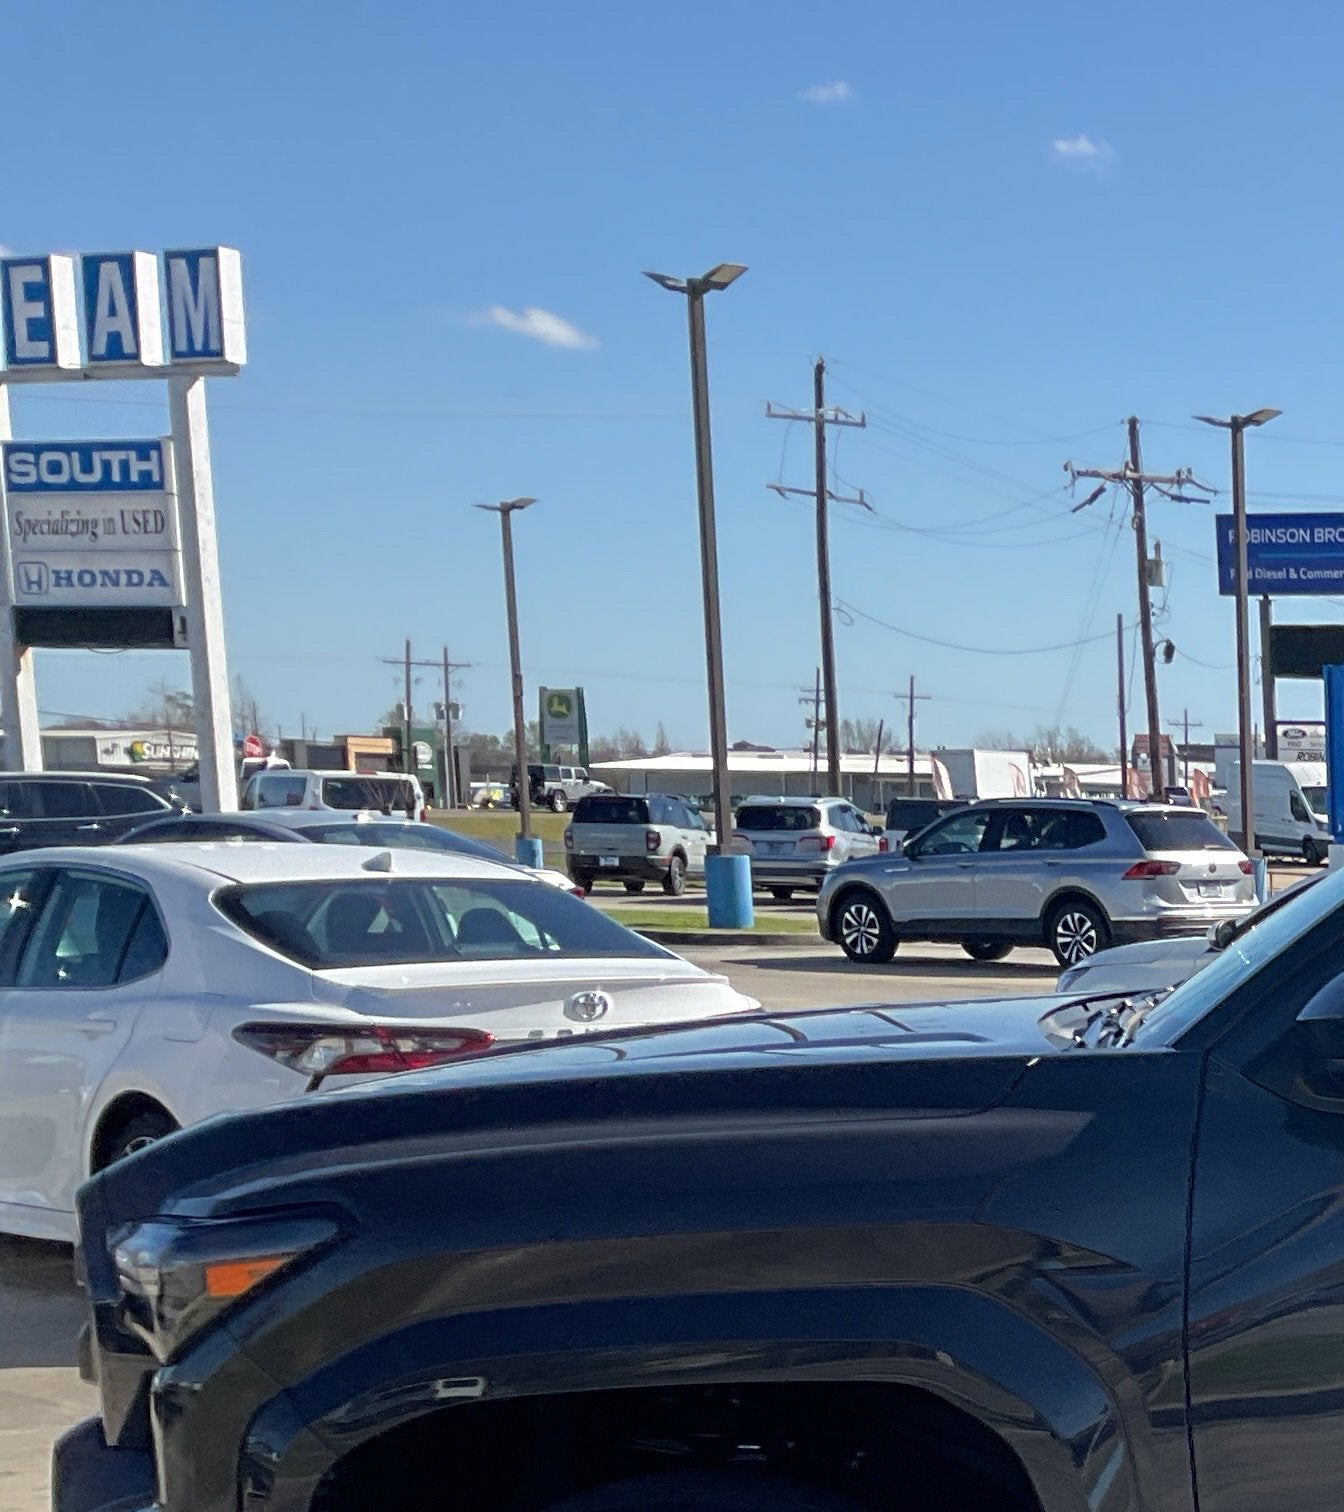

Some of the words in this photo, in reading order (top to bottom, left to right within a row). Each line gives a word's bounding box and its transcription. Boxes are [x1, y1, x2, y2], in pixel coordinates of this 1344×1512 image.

[8, 450, 161, 485] SOUTH
[14, 510, 99, 544] Specializing
[102, 510, 117, 536] in
[120, 509, 165, 535] USED
[51, 568, 170, 588] HONDA
[1255, 567, 1287, 580] Diesel
[1289, 567, 1298, 579] &
